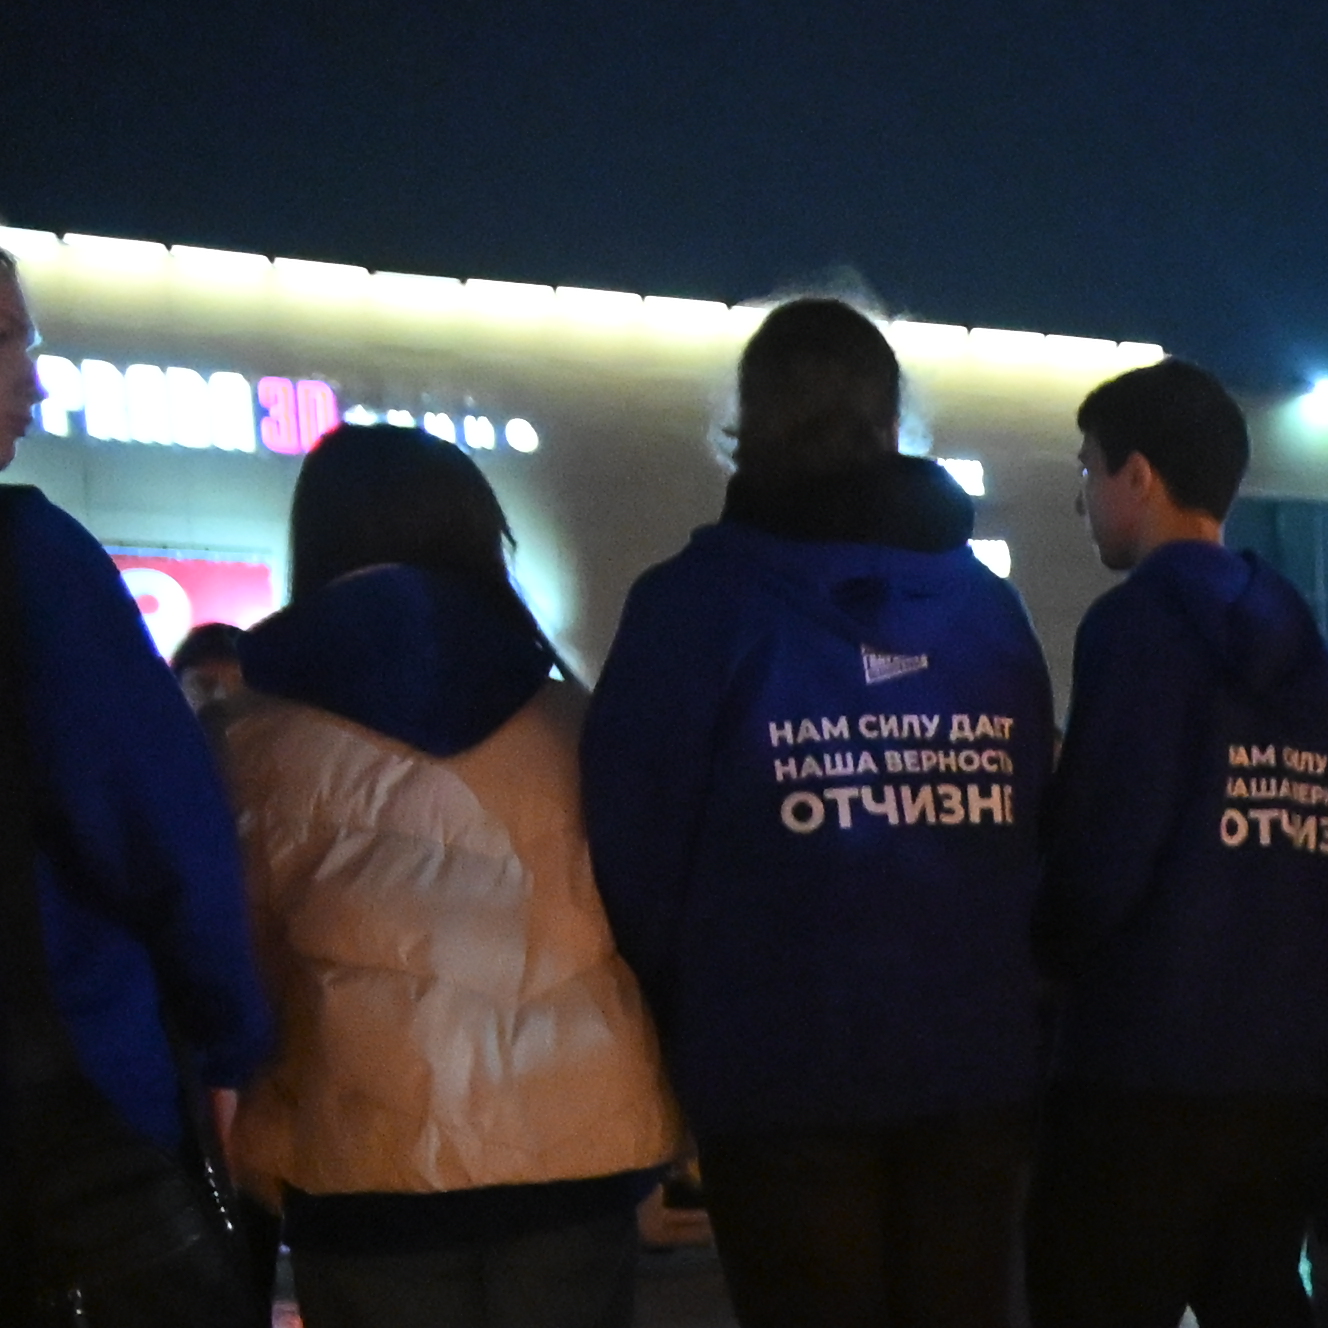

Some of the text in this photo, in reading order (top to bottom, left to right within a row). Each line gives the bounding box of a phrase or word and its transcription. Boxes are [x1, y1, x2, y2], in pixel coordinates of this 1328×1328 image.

[769, 715, 850, 747] НАМ
[858, 713, 940, 740] СИЛУ
[774, 750, 879, 782] НАША
